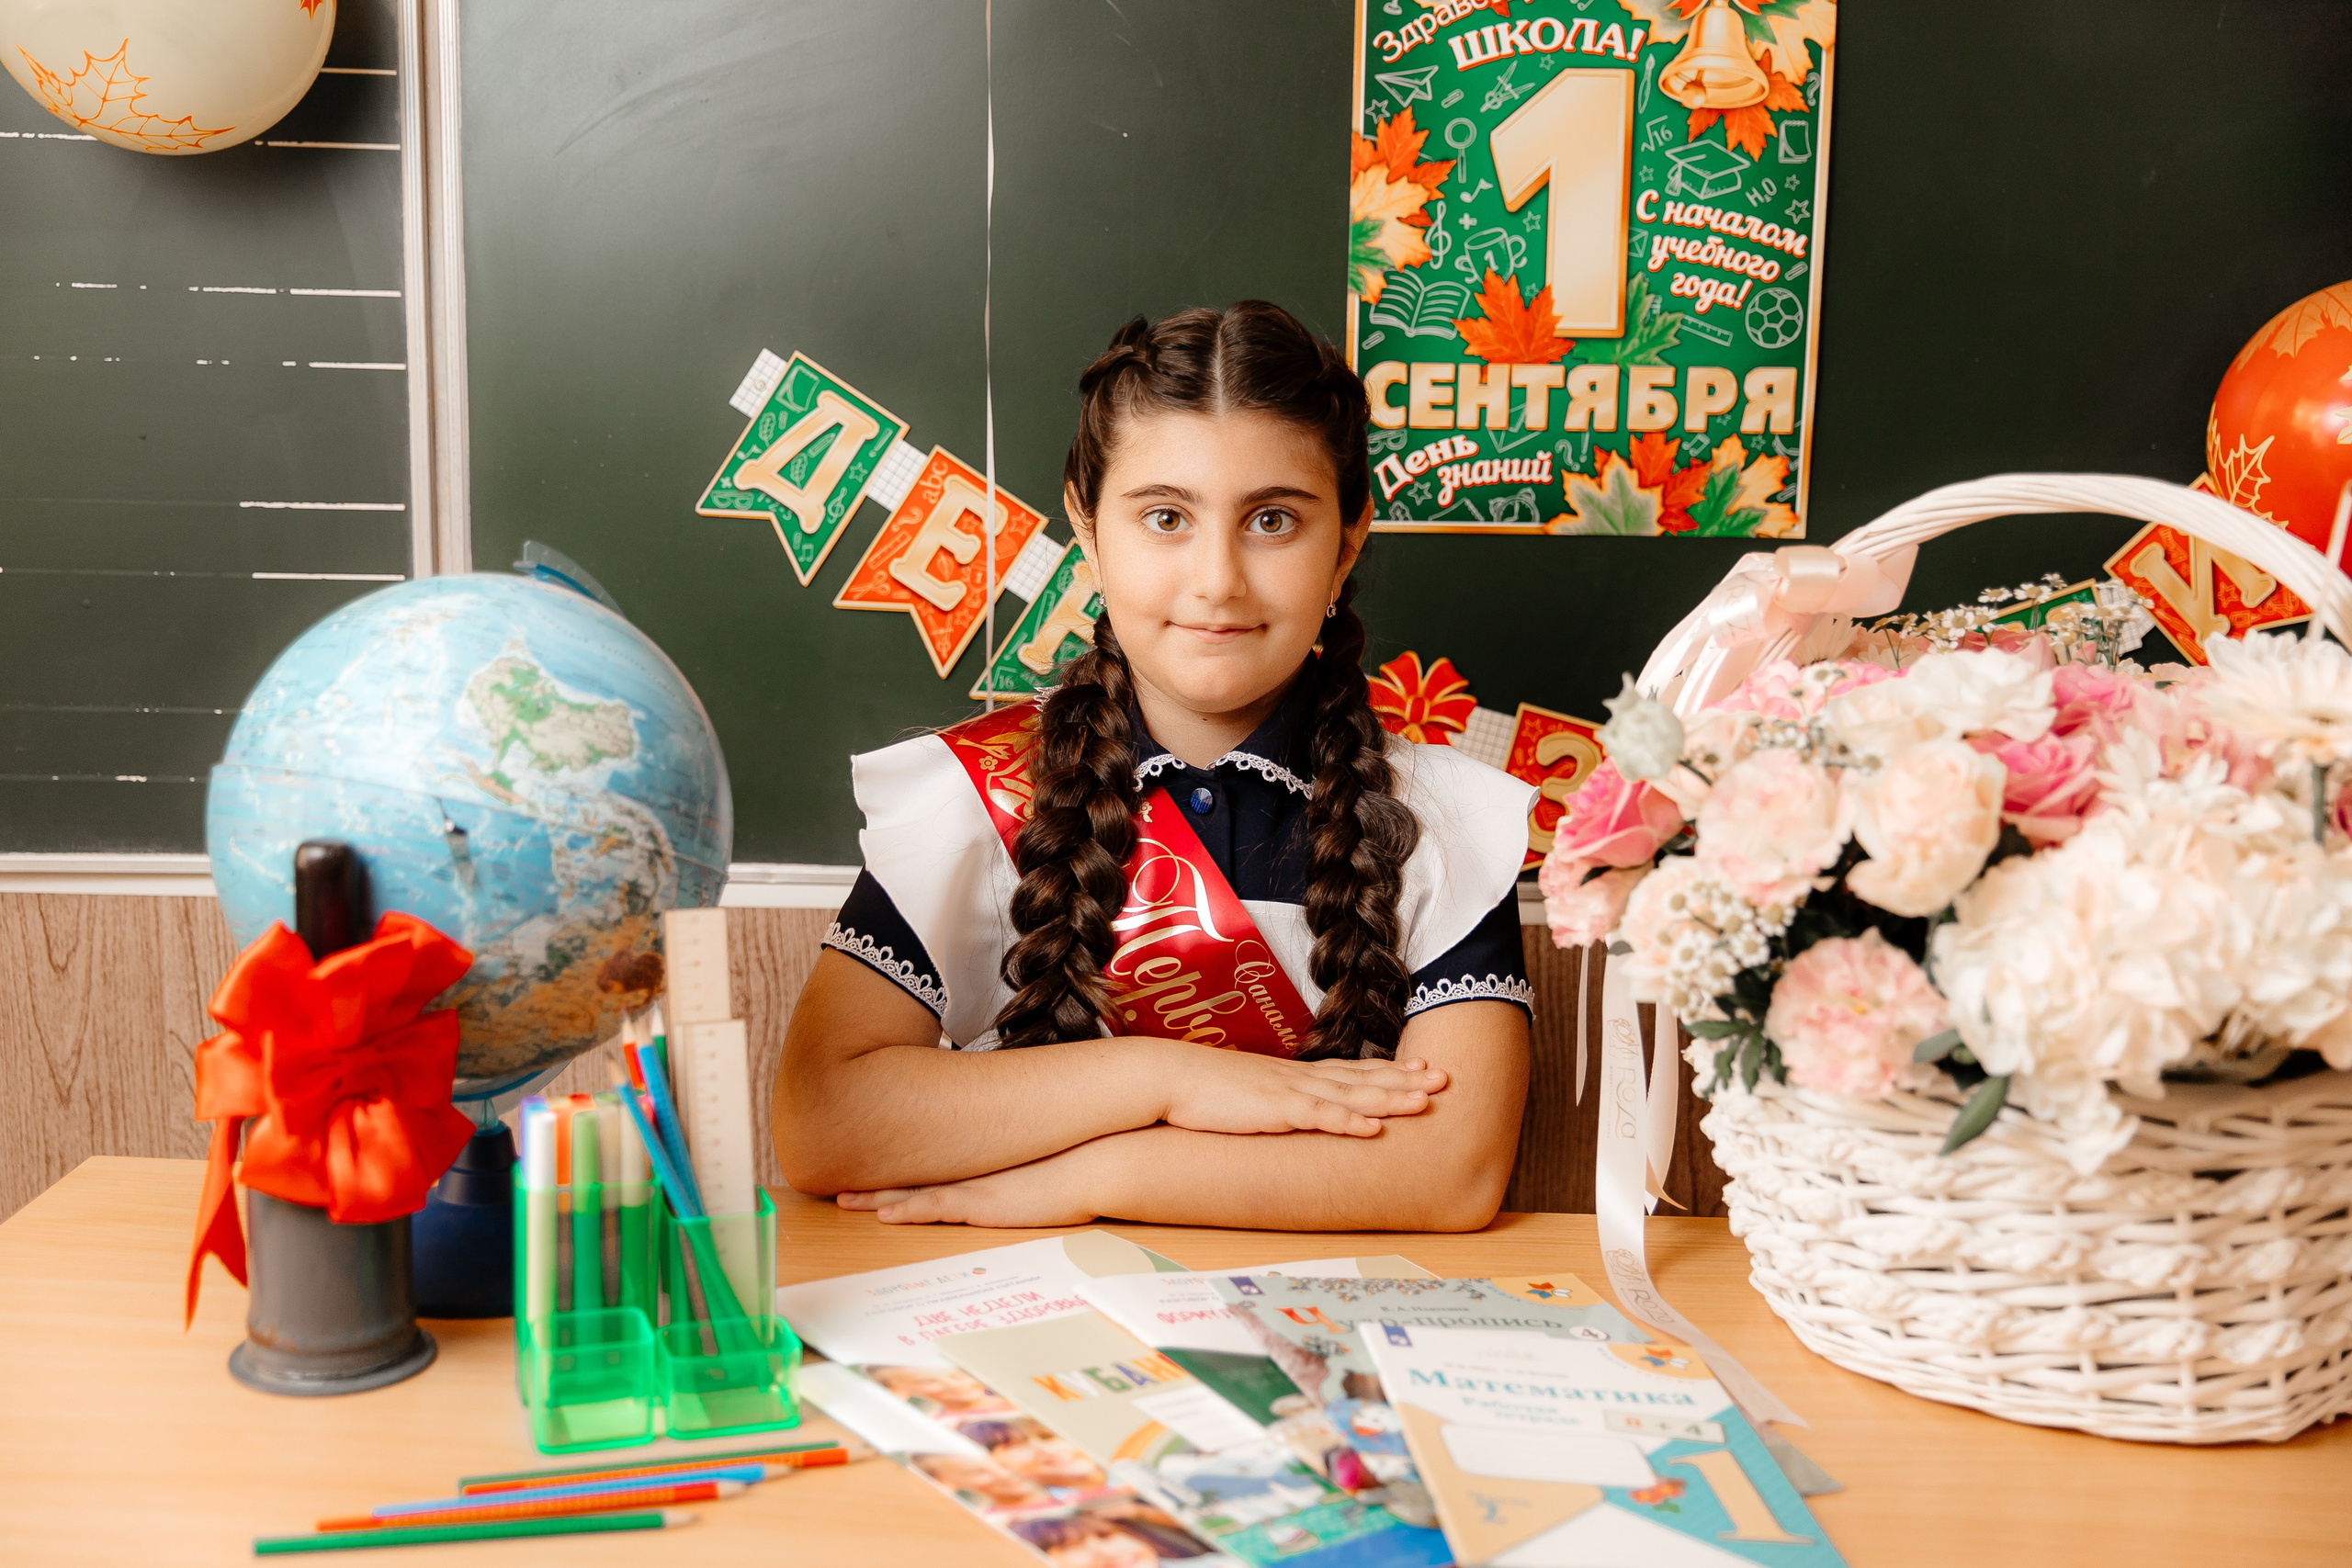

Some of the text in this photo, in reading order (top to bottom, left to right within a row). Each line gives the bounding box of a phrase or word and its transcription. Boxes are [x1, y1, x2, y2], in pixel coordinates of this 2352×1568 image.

[1448, 17, 1647, 72] ШКОЛА!
[1490, 67, 1635, 339] 1
[1635, 189, 1809, 259] С началом
[1647, 234, 1781, 283] учебного
[1669, 272, 1754, 315] года!
[1363, 360, 1799, 435] СЕНТЯБРЯ
[1374, 434, 1481, 502] День
[1436, 450, 1555, 508] знаний
[1110, 837, 1247, 1051] Перво
[1408, 1368, 1698, 1406] Математика
[1667, 1449, 1815, 1546] 1
